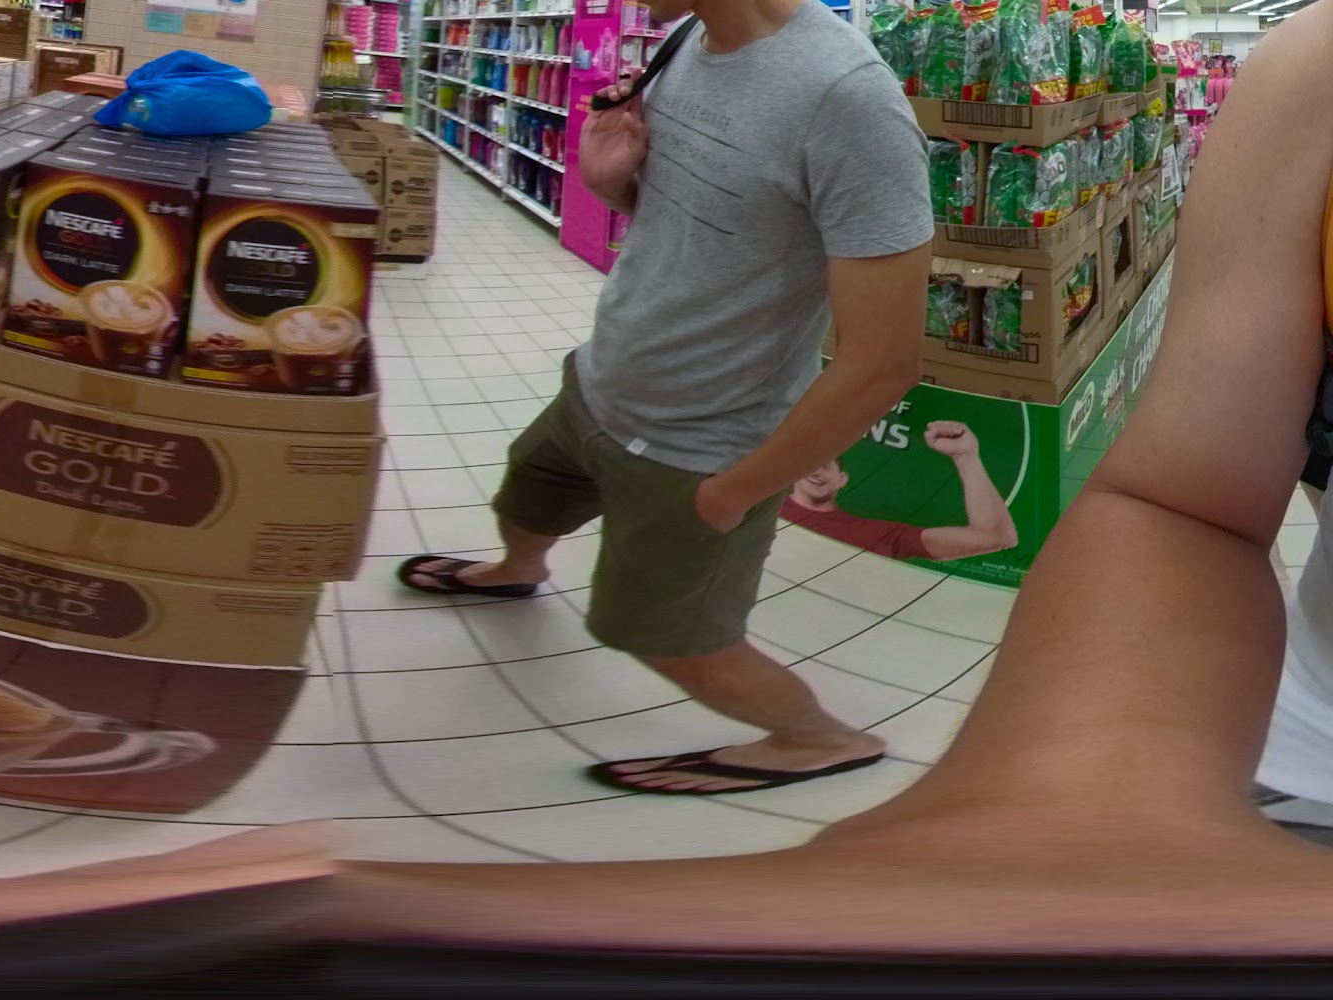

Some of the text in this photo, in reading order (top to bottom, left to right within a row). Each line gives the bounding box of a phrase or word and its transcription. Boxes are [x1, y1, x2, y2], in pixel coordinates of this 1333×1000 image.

[42, 250, 121, 274] DARK LATTE
[225, 282, 307, 299] DARK LATTE
[28, 419, 180, 469] NESCAFÉ
[24, 450, 170, 497] GOLD
[35, 480, 148, 513] Dark Latte
